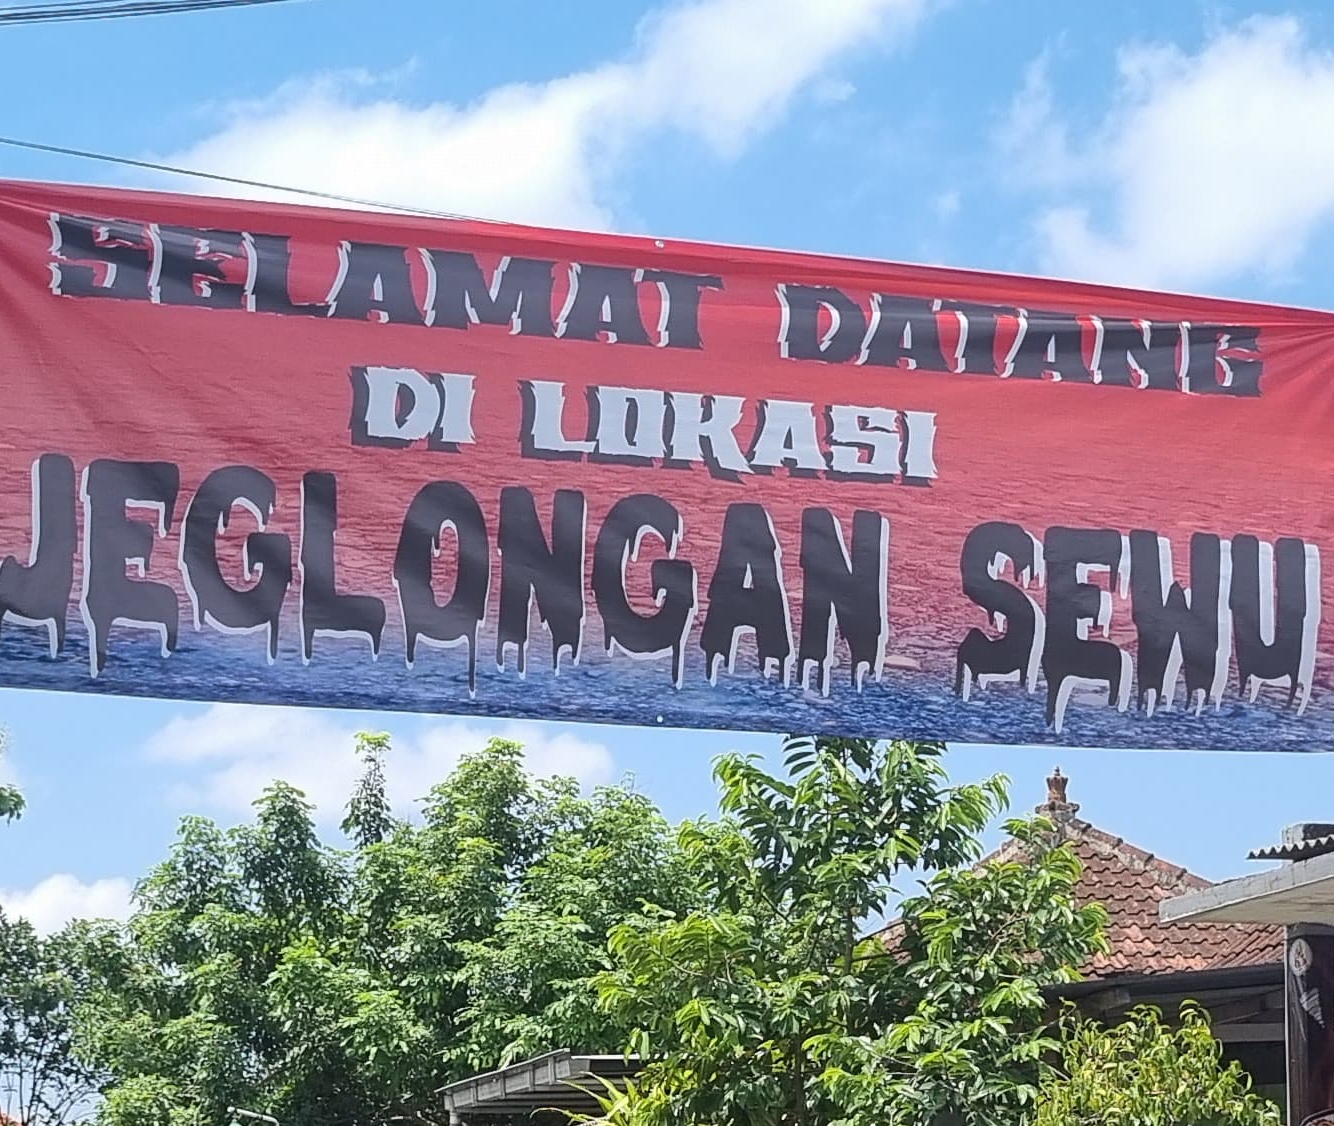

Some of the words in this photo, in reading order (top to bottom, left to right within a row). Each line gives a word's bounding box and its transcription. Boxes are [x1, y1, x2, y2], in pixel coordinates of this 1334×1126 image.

[47, 211, 725, 351] SELAMAT
[777, 282, 1264, 398] DATANG
[351, 364, 475, 450] DI
[518, 379, 939, 487] LOKASI
[956, 520, 1321, 735] SEWU
